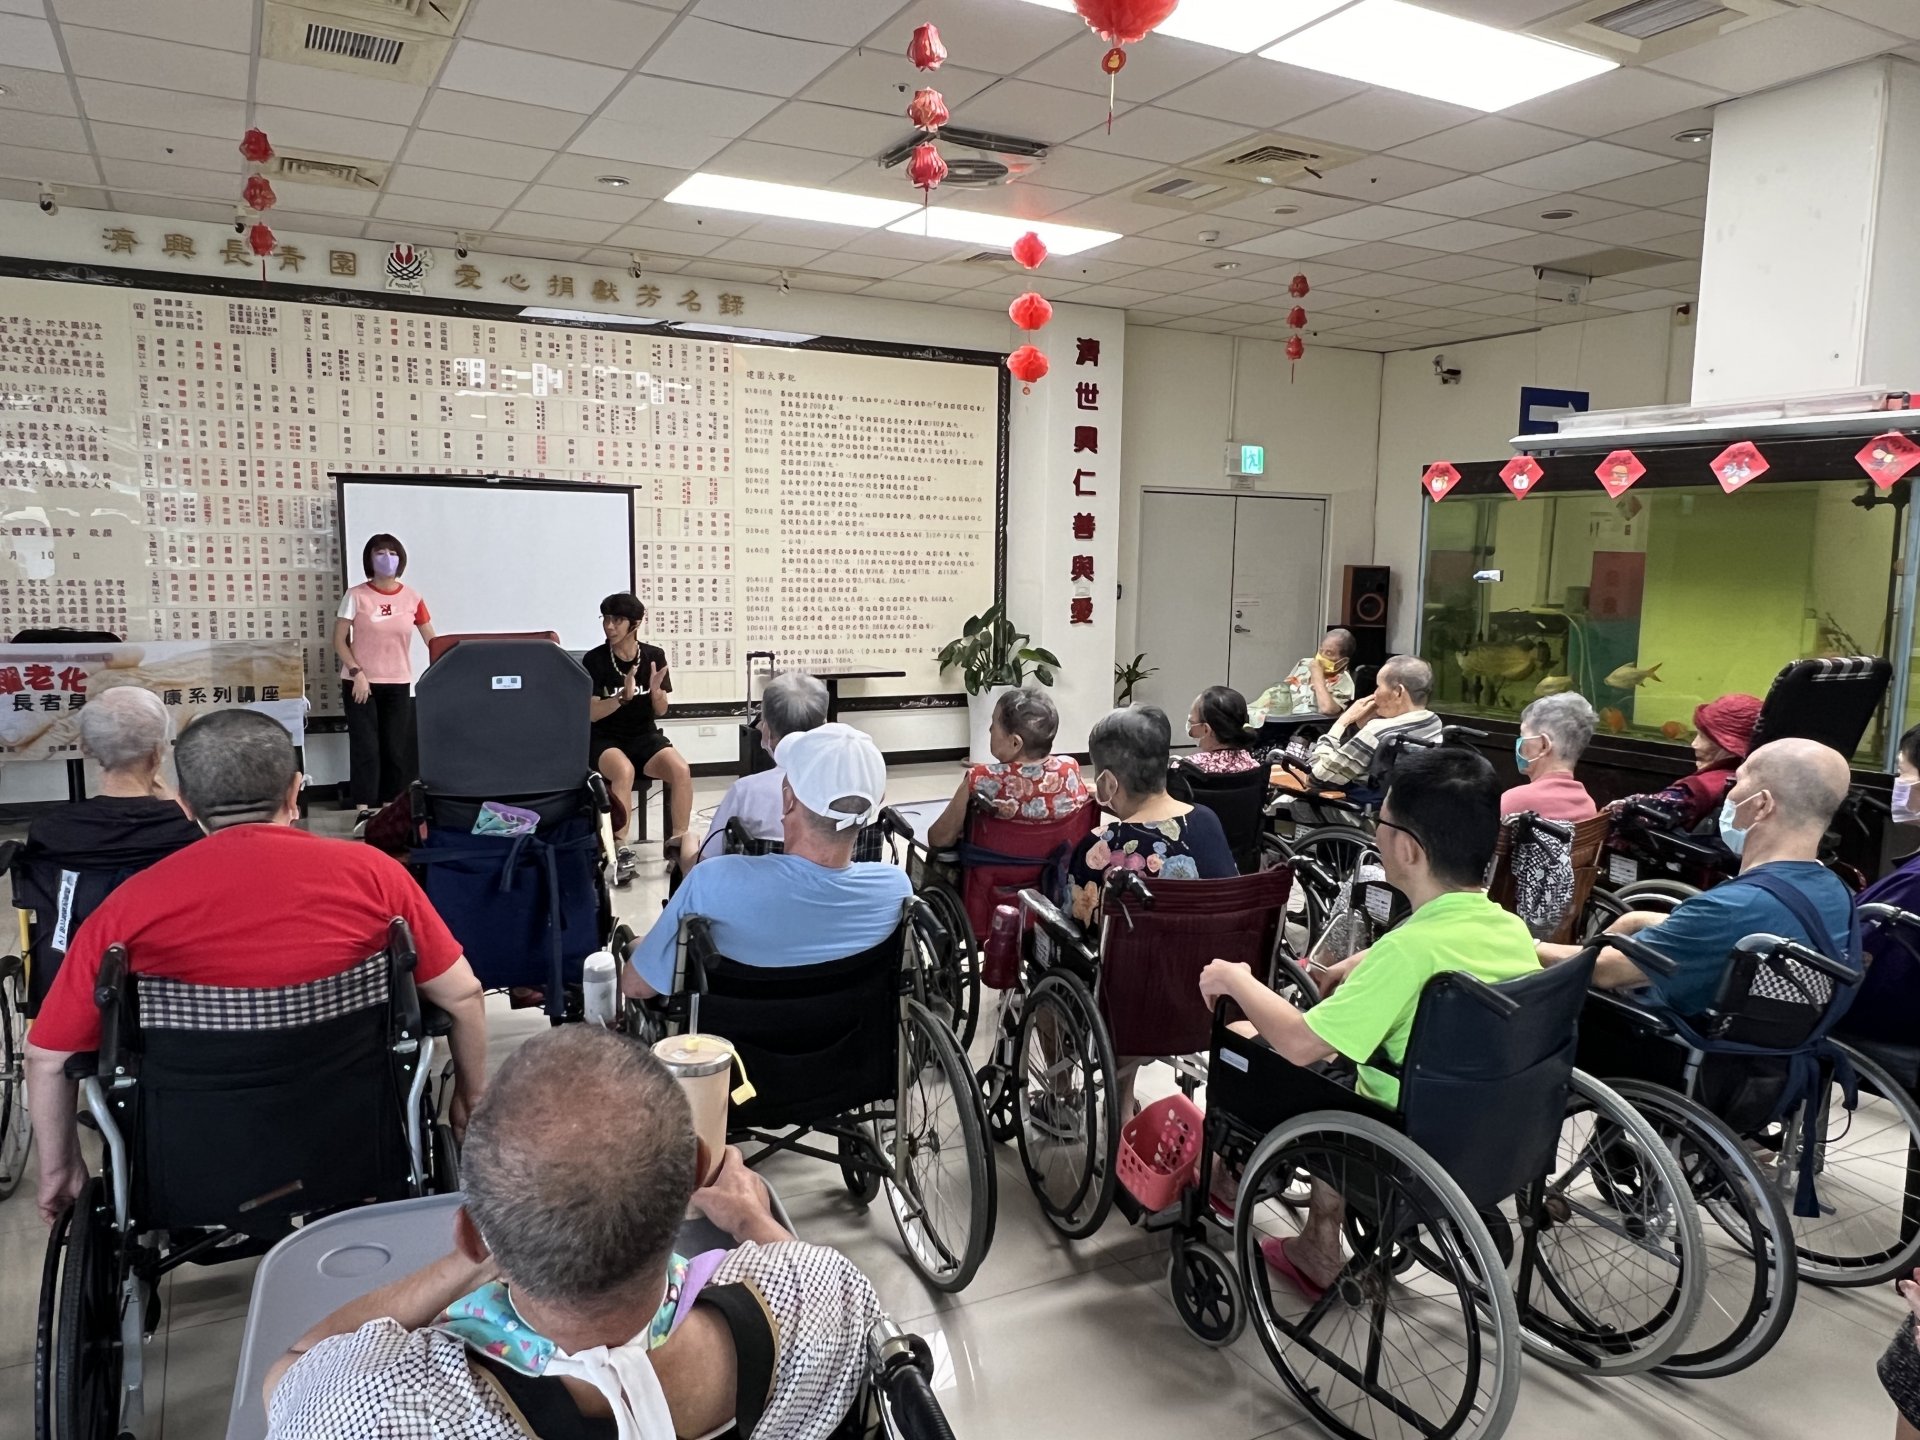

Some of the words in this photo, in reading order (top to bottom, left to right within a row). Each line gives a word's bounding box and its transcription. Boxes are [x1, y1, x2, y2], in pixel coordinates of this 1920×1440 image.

[103, 226, 357, 276] 濟興長青園
[454, 264, 745, 316] 愛心捐獻芳名錄
